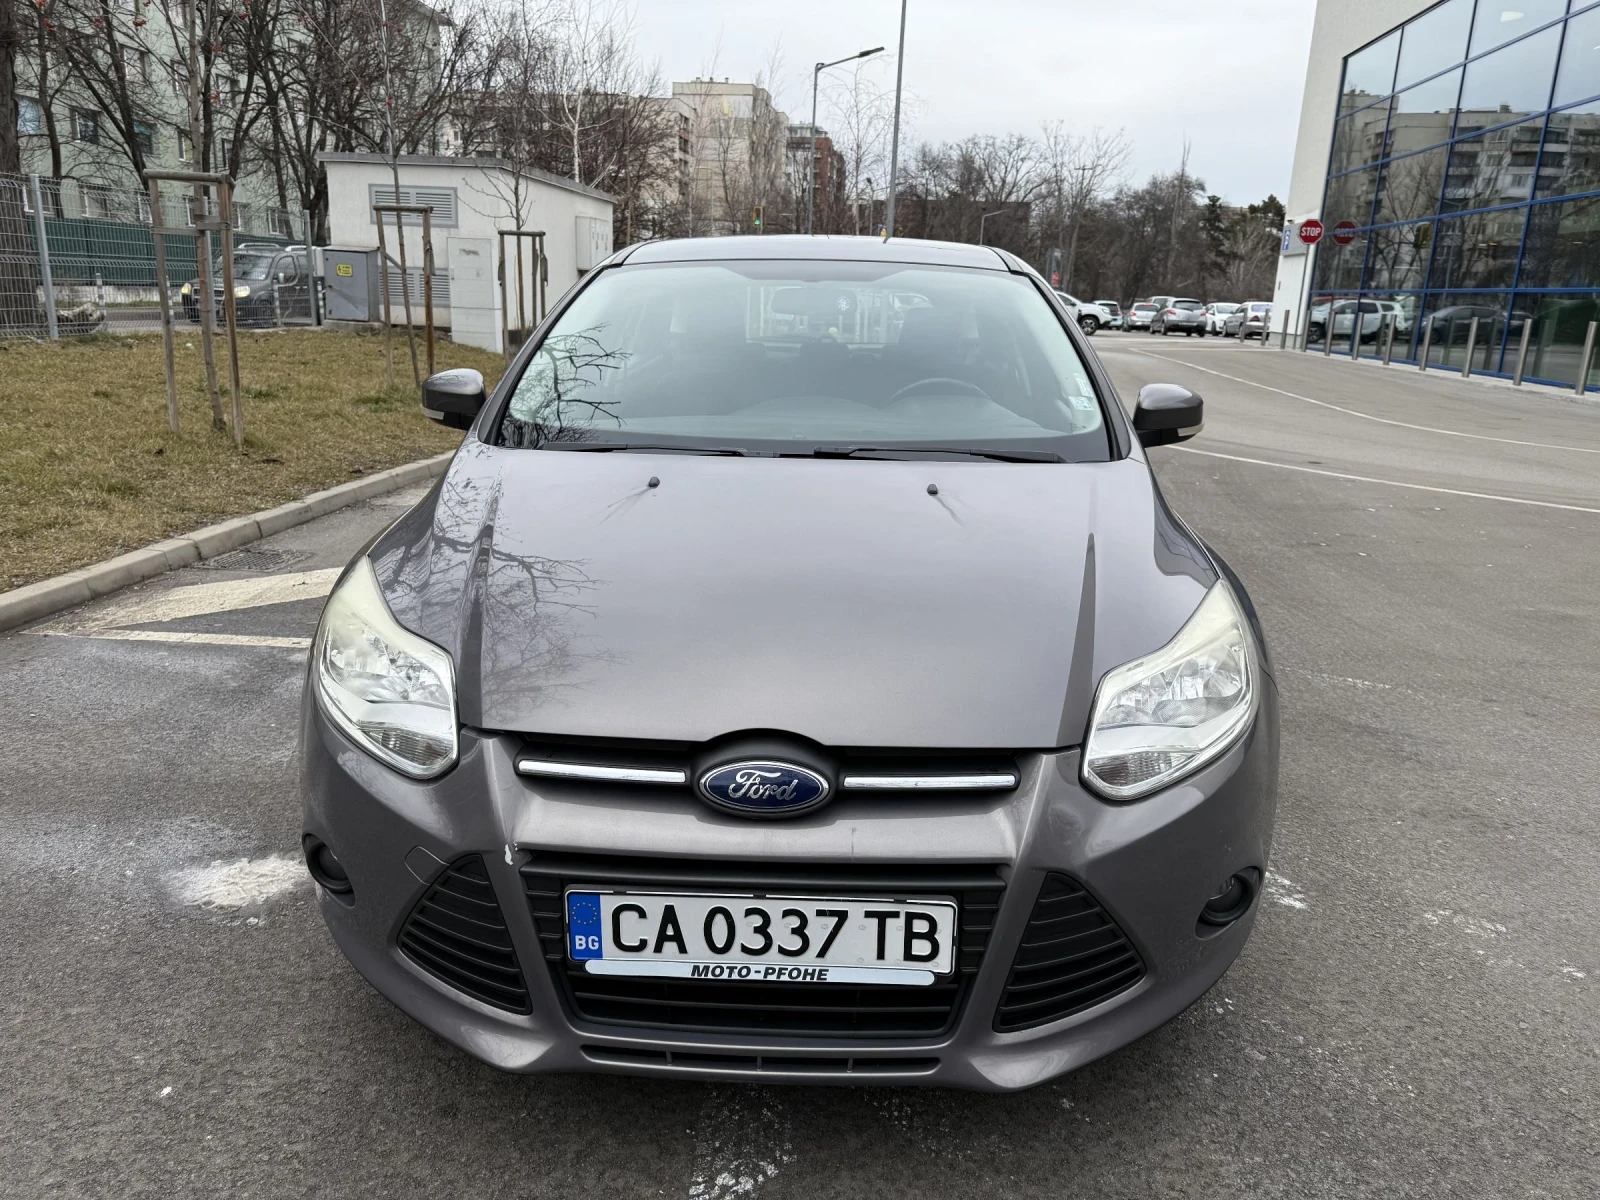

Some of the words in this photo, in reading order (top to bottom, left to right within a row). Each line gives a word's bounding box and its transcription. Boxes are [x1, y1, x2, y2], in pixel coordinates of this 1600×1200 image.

[1301, 227, 1320, 236] STOP
[728, 770, 798, 801] Ford
[611, 903, 688, 955] CA
[703, 905, 849, 959] 0337
[864, 910, 941, 963] TB
[575, 935, 599, 950] BG
[690, 964, 829, 982] MOTO-PFOHE
